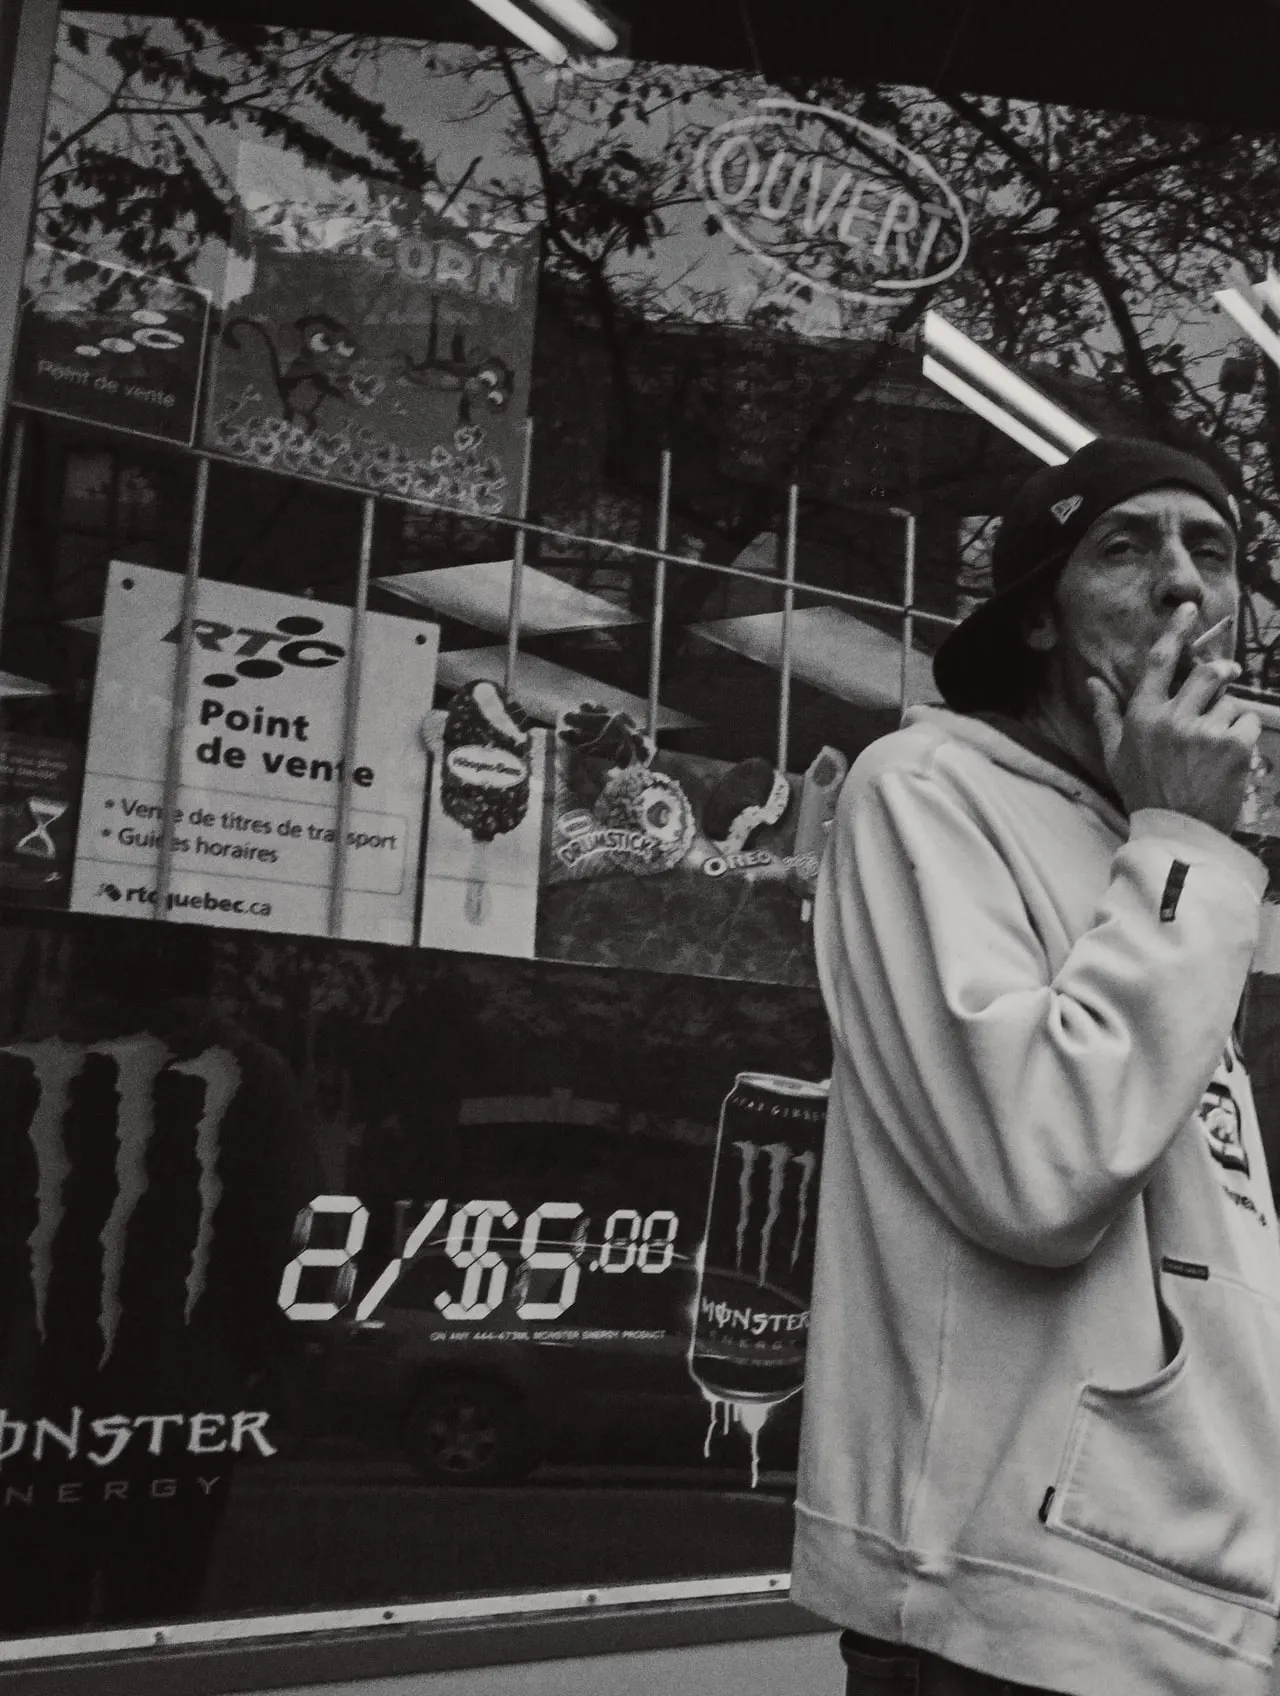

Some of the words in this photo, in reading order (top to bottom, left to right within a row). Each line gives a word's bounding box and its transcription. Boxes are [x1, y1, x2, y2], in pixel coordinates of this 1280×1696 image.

[710, 136, 952, 273] OUVERT
[36, 359, 90, 385] Point
[94, 375, 119, 394] de
[125, 383, 176, 409] vente
[160, 617, 346, 669] RTC
[200, 699, 310, 742] Point
[196, 737, 246, 768] de
[189, 807, 216, 827] de
[221, 810, 272, 835] titres
[277, 819, 303, 838] de
[195, 835, 278, 864] horaires
[430, 1331, 446, 1342] ON
[450, 1331, 470, 1342] ANY
[533, 1330, 580, 1341] MONSTER
[581, 1329, 620, 1341] ENERGY
[621, 1329, 668, 1341] PRODUCT
